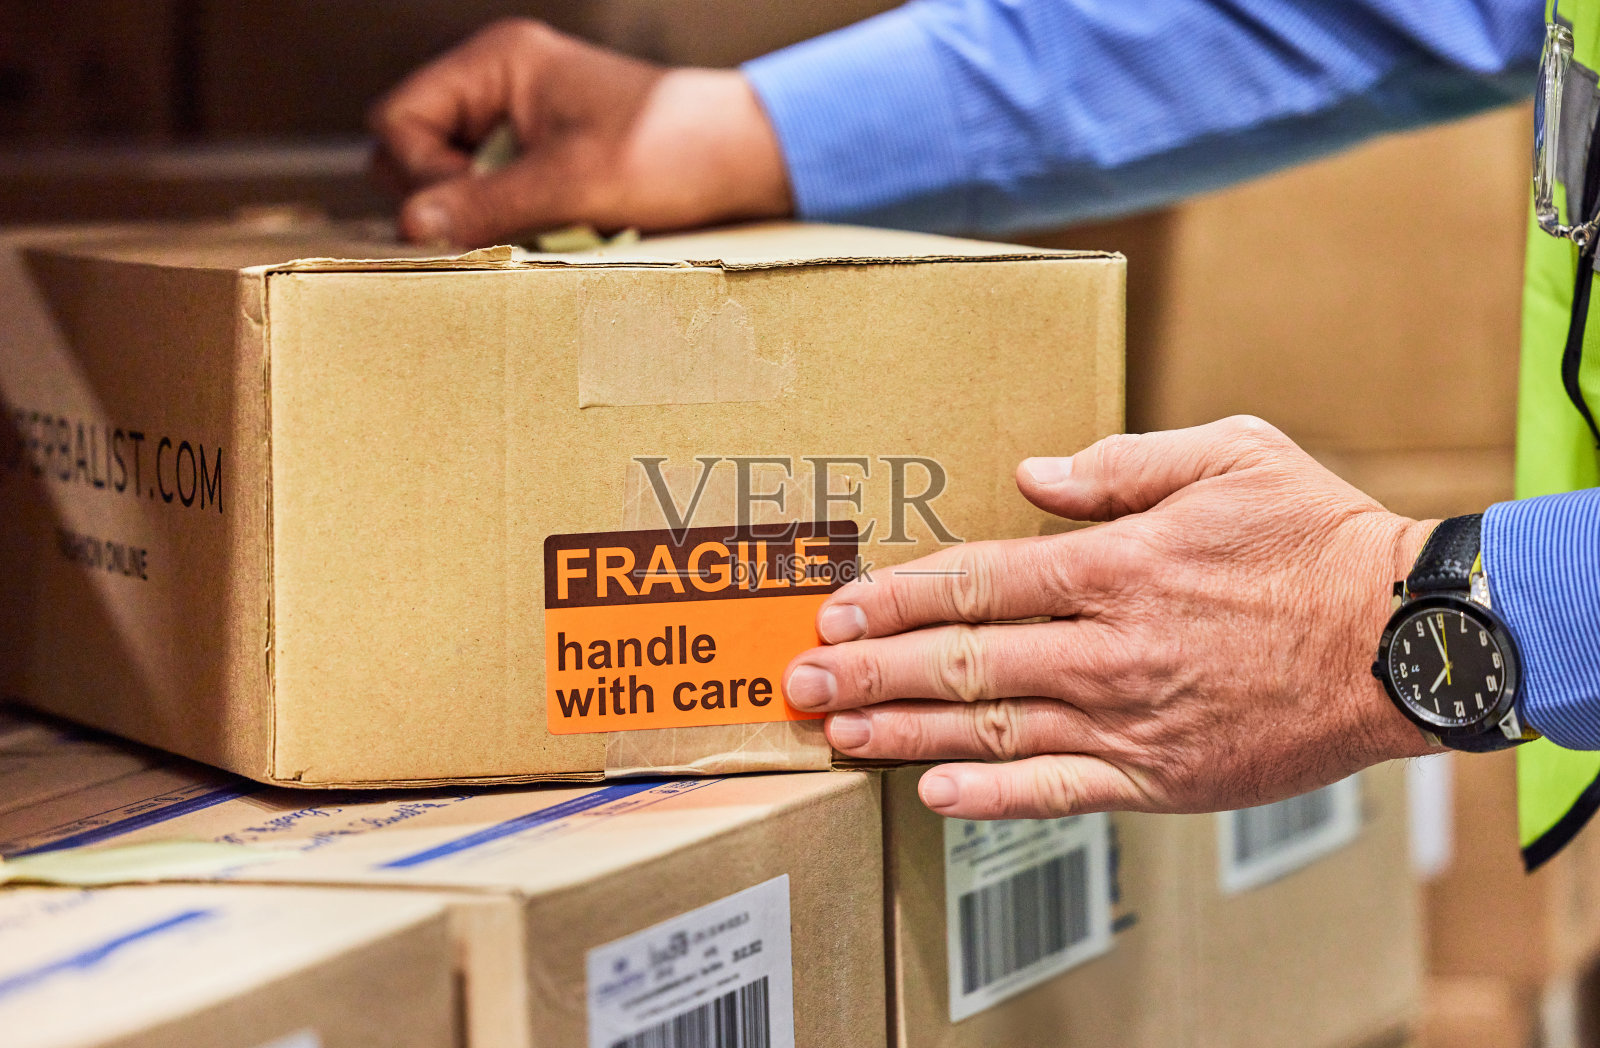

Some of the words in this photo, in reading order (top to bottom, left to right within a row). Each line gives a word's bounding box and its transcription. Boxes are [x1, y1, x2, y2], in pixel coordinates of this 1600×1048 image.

[556, 536, 832, 600] FRAGILE
[1416, 620, 1425, 637] 5
[1461, 617, 1468, 633] 7
[1403, 639, 1410, 655] 4
[1479, 630, 1487, 647] 8
[557, 625, 717, 671] handle
[1492, 652, 1500, 669] 9
[1400, 662, 1408, 678] 3
[1412, 684, 1421, 700] 2
[1486, 675, 1498, 692] 10
[556, 676, 655, 718] with
[673, 676, 773, 711] care
[1434, 697, 1440, 714] 1
[1475, 693, 1484, 709] 11
[1453, 700, 1466, 717] 12
